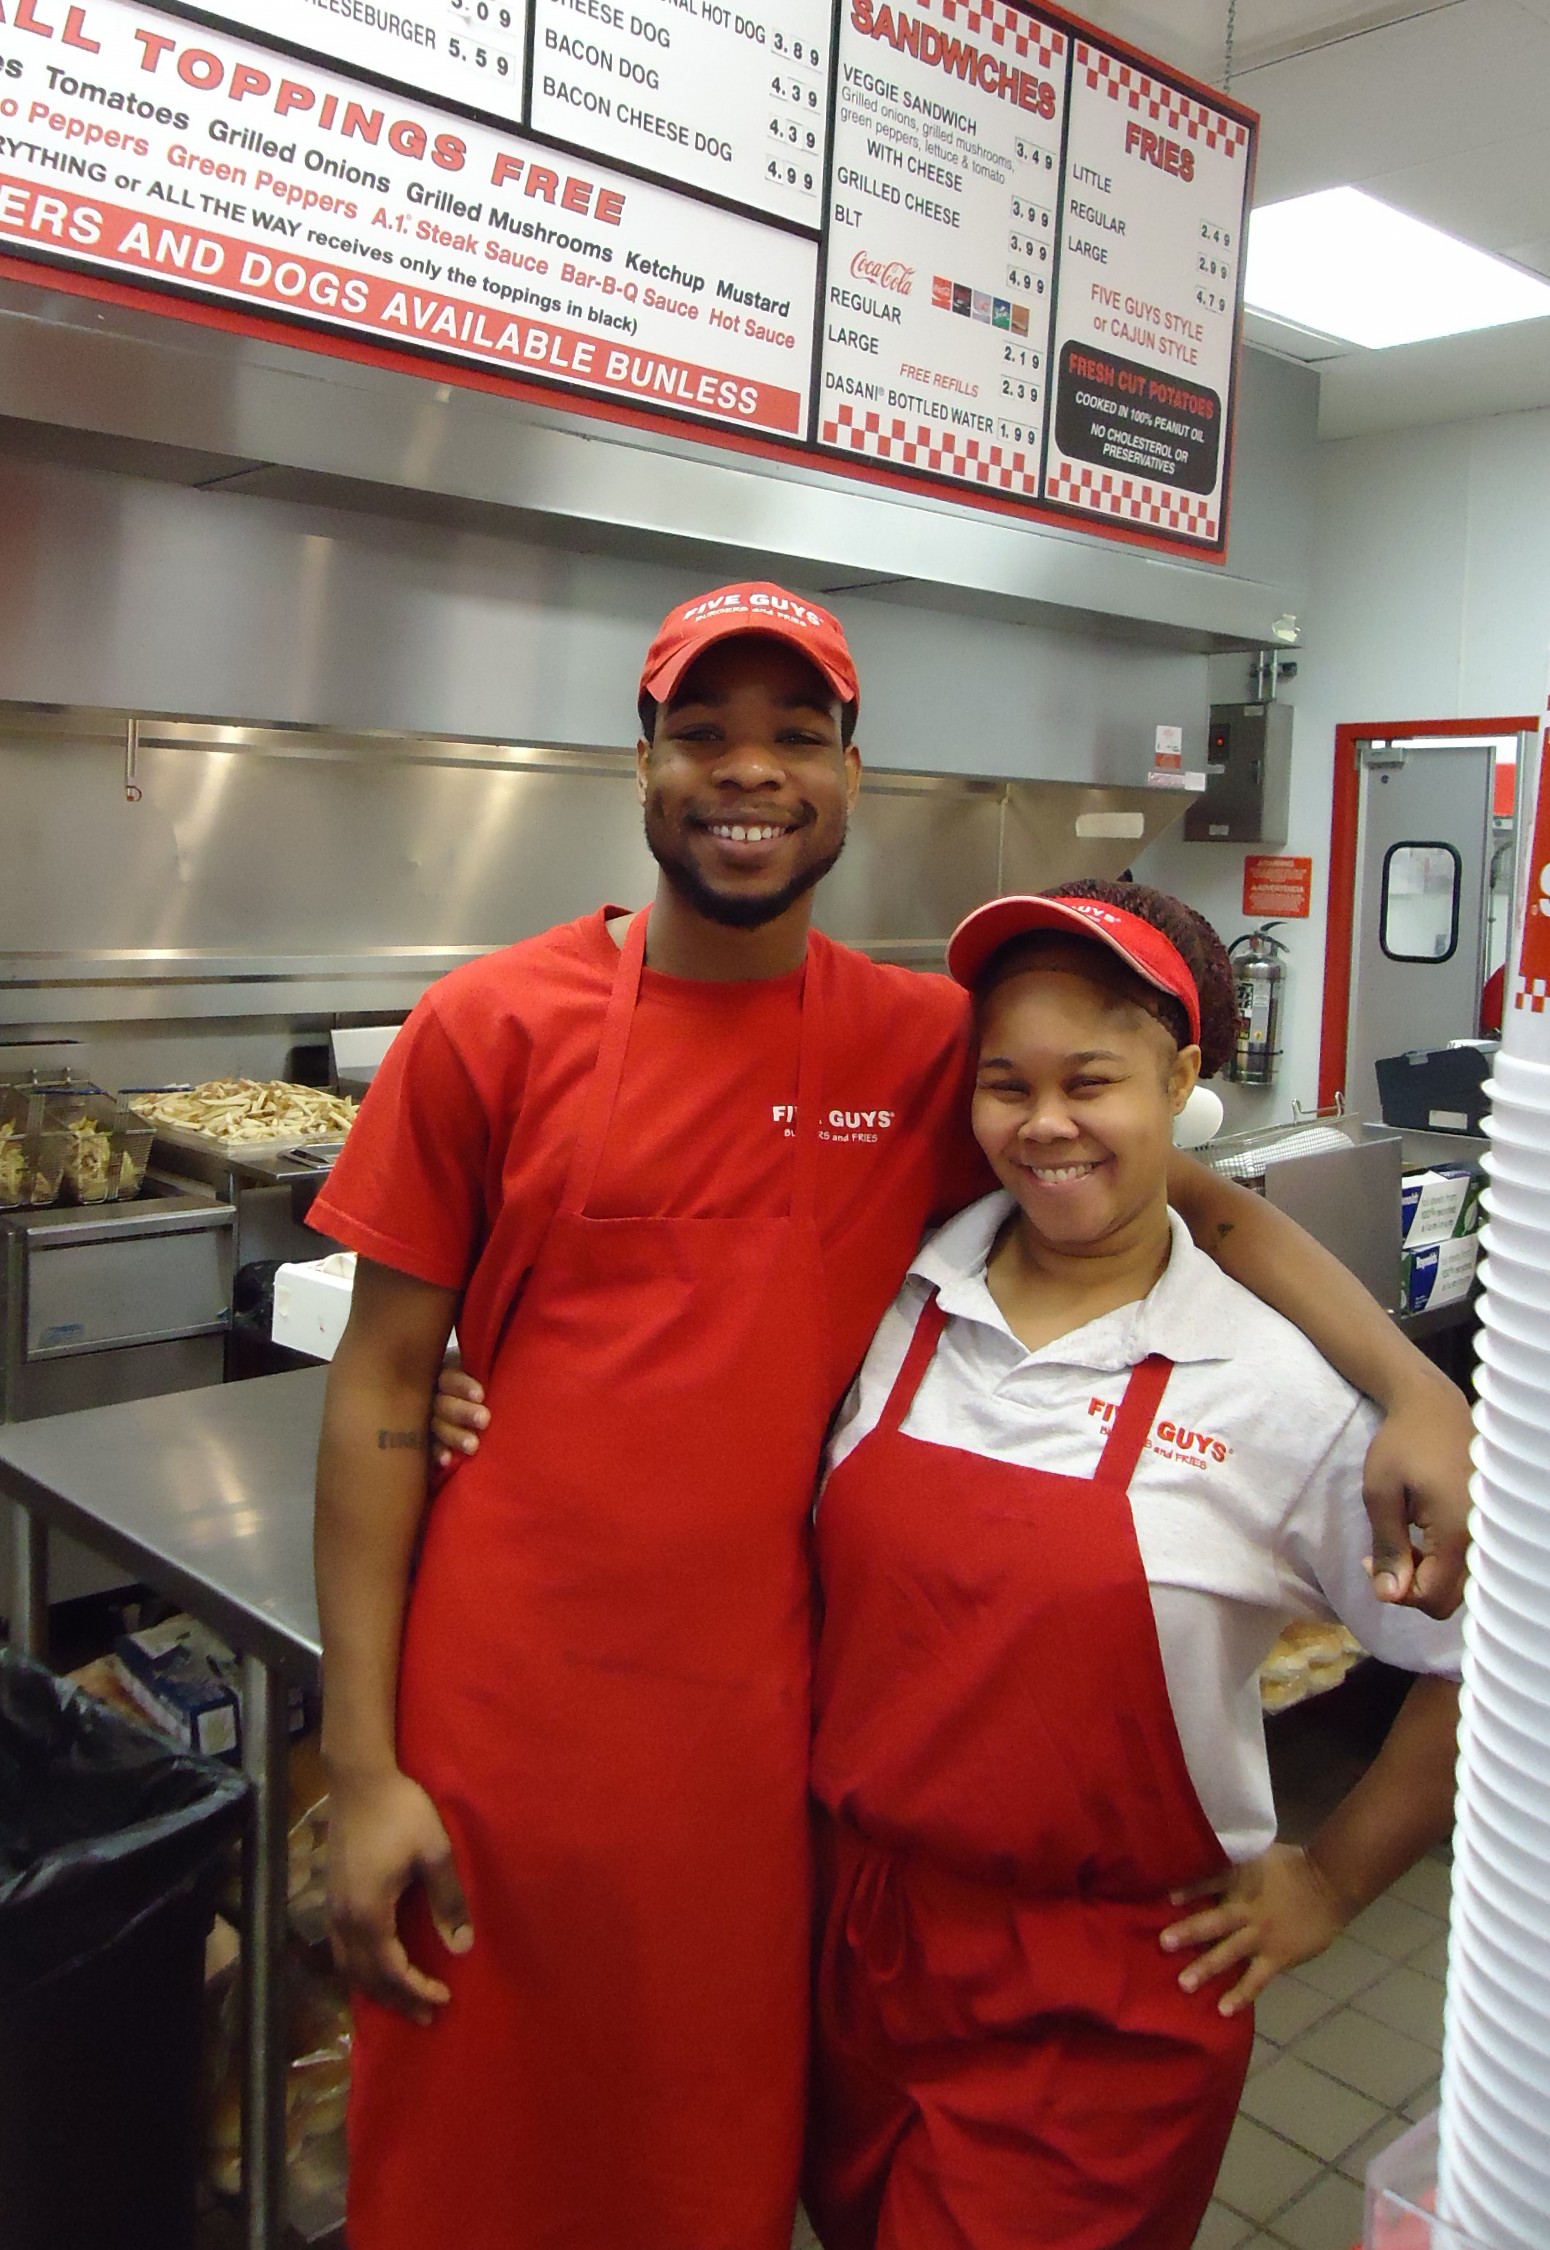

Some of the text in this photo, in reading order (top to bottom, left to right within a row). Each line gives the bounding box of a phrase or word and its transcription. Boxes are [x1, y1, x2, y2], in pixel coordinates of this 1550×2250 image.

[630, 15, 671, 48] DOG
[702, 1, 732, 29] HOT
[734, 15, 766, 44] DOG
[448, 38, 509, 76] 5.59
[545, 28, 660, 90] BACON DOG
[774, 33, 820, 67] 3.89
[850, 0, 1057, 121] SANDWICHES
[771, 76, 818, 108] 4.39
[843, 63, 977, 137] VEGGIE SANDWICH
[134, 28, 467, 172] TOPPINGS
[490, 152, 627, 227] FREE
[542, 76, 733, 162] BACON CHEESE DOG
[769, 118, 815, 149] 4.39
[841, 85, 1015, 173] Grilled onions, grilled mushrooms,
[840, 107, 1006, 185] green peppers, lettuce & tomato
[1015, 142, 1053, 170] 3.49
[1124, 120, 1195, 183] FRIES
[767, 161, 813, 191] 4.99
[866, 138, 963, 192] WITH CHEESE
[1072, 163, 1112, 194] LITTLE
[46, 65, 190, 131] Tomatoes
[209, 119, 296, 163] Grilled
[304, 149, 391, 194] Onions
[406, 182, 482, 222] Grilled
[488, 208, 614, 264] Mushrooms
[625, 250, 706, 294] Ketchup
[715, 279, 791, 318] Mustard
[837, 166, 961, 229] GRILLED CHEESE
[28, 101, 149, 157] Peppers
[167, 144, 247, 185] Green
[255, 169, 358, 219] Peppers
[415, 219, 479, 255] Steak
[484, 238, 549, 275] Sauce
[561, 263, 639, 303] Bar-B-Q
[642, 288, 699, 320] Sauce
[708, 308, 740, 334] Hot
[744, 320, 796, 349] Sauce
[834, 203, 863, 228] BLT
[1012, 200, 1049, 228] 3.99
[1069, 199, 1126, 236] REGULAR
[1010, 235, 1047, 261] 3.99
[1068, 235, 1108, 264] LARGE
[1201, 224, 1231, 247] 2.49
[114, 174, 141, 192] or
[146, 180, 195, 209] ALL
[199, 193, 247, 224] THE
[251, 210, 302, 238] WAY
[307, 229, 394, 264] receives
[399, 256, 442, 281] only
[447, 266, 478, 288] the
[482, 276, 562, 313] toppings
[566, 299, 583, 319] in
[587, 306, 639, 337] black)
[1199, 257, 1228, 279] 2.99
[1008, 269, 1044, 294] 4.99
[118, 221, 226, 276] AND
[239, 251, 370, 314] DOGS
[380, 292, 598, 374] AVAILABLE
[605, 350, 760, 415] BUNLESS
[830, 286, 902, 325] REGULAR
[1091, 283, 1204, 342] FIVE GUYS STYLE
[1196, 290, 1226, 312] 4.79
[828, 324, 879, 355] LARGE
[1004, 345, 1040, 370] 2.19
[1093, 316, 1198, 366] or CAJUN STYLE
[899, 363, 980, 398] FREE REFILLS
[1002, 379, 1038, 403] 2.39
[1069, 352, 1214, 420] FRESH CUT POTATOES
[888, 389, 949, 421] BOTTLED
[951, 408, 994, 434] WATER
[1075, 391, 1205, 443] COOKED IN 100% PEANUT OIL
[1000, 424, 1036, 446] 1.99
[1090, 422, 1189, 463] NO CHOLESTEROL OR
[1102, 442, 1176, 475] PRESERVATIVES
[683, 593, 820, 626] FIVE GUYS
[829, 1110, 892, 1128] GUYS
[832, 1133, 849, 1142] and
[852, 1133, 878, 1143] FRIES
[1153, 1446, 1208, 1470] and FRIES
[1157, 1420, 1227, 1463] GUYS
